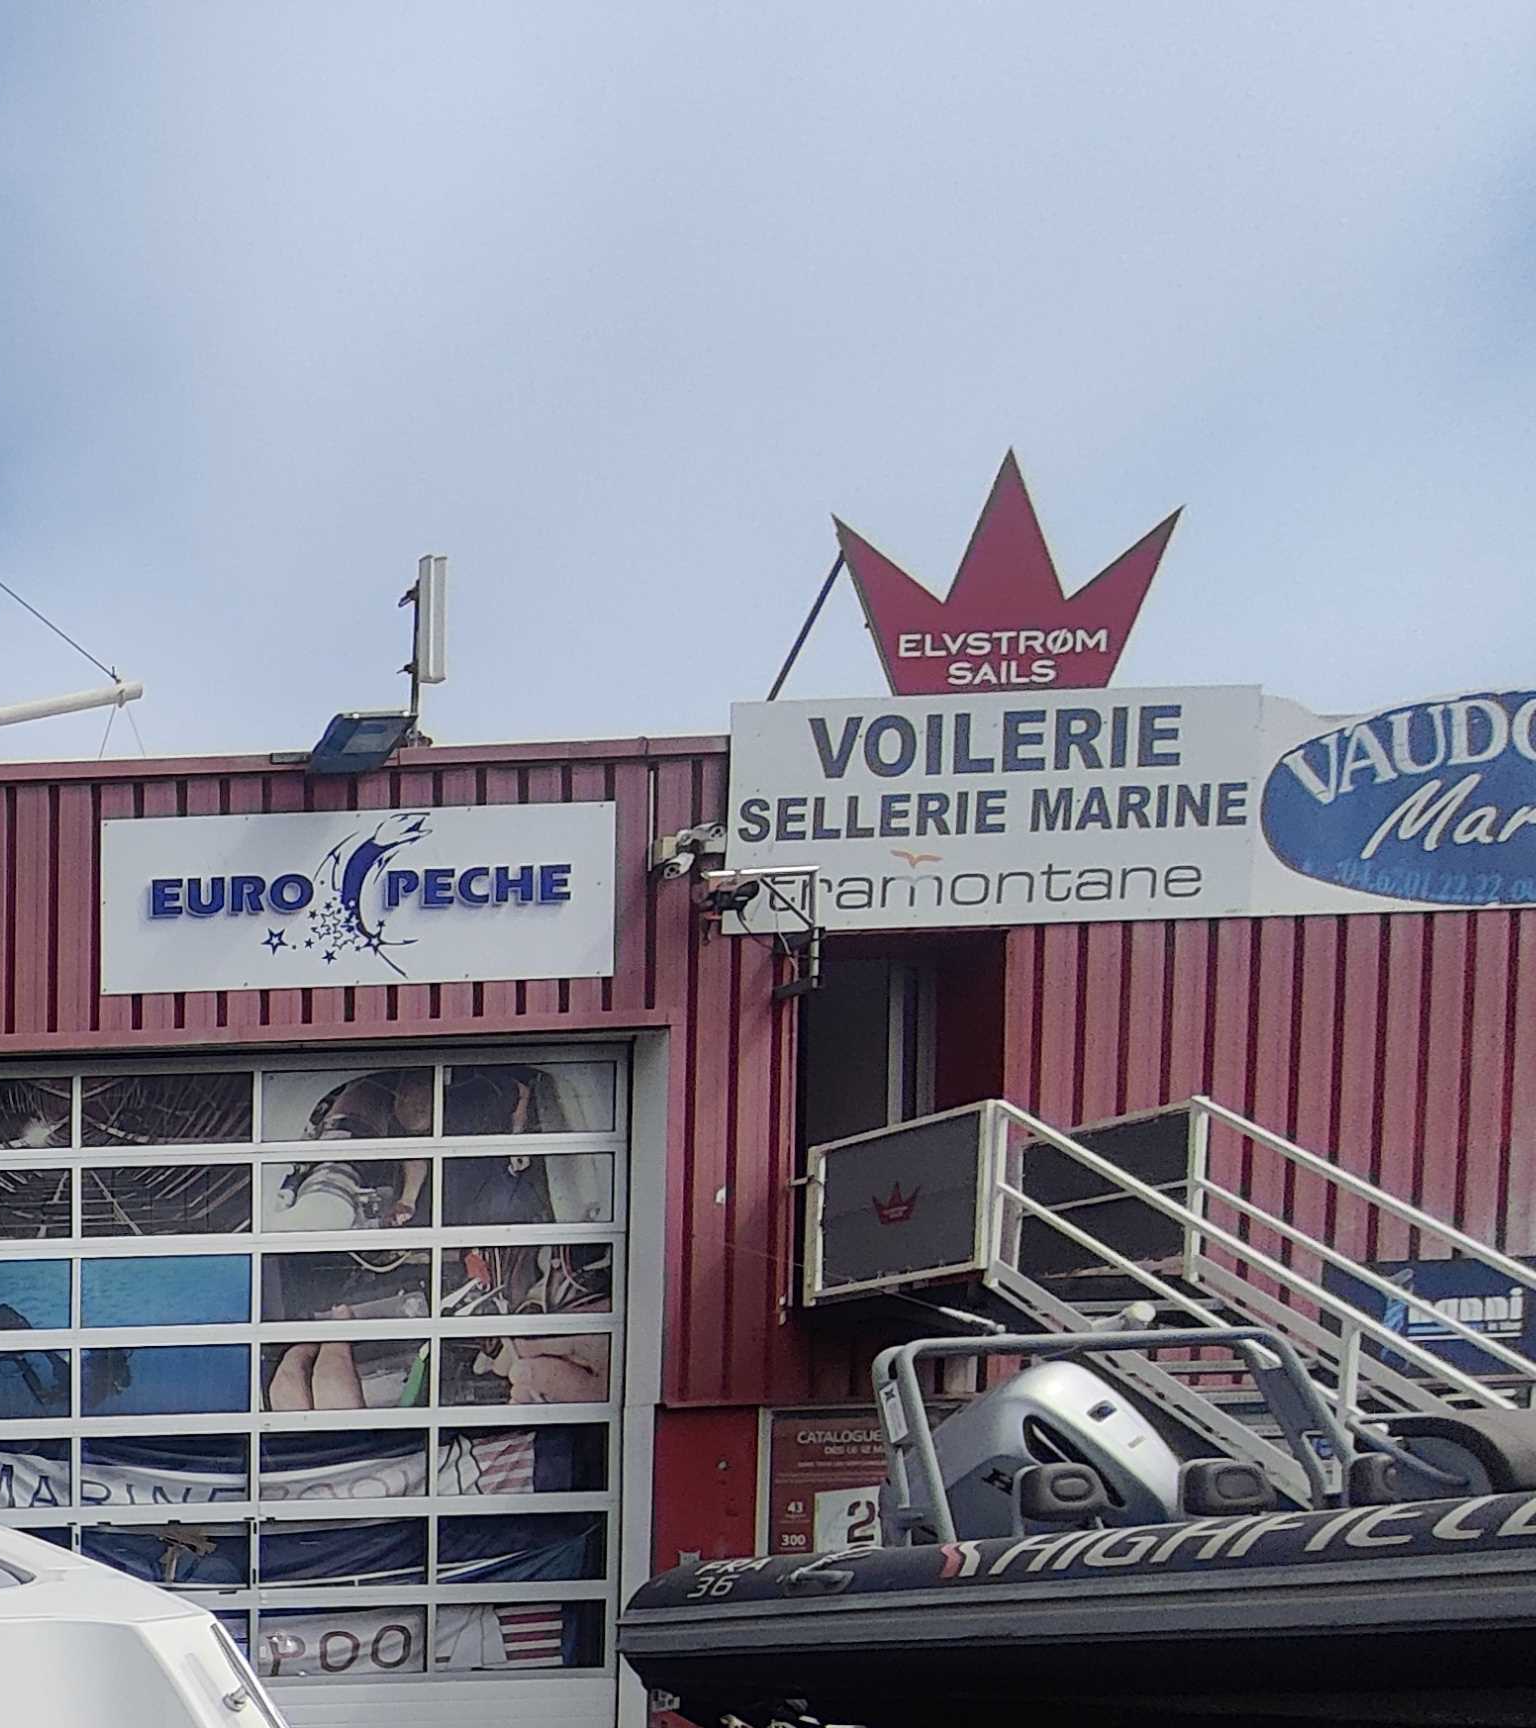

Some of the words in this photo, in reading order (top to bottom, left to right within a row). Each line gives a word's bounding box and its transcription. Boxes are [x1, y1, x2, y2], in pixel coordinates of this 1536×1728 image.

[897, 625, 1110, 659] ELVSTRØM
[947, 656, 1059, 687] SAILS
[808, 703, 1183, 779] VOILERIE
[738, 787, 1007, 844] SELLERIE
[1029, 781, 1249, 834] MARINE
[149, 872, 315, 918] EURO
[385, 863, 573, 908] PECHE
[768, 862, 1203, 911] tramontane
[781, 1534, 806, 1546] 300
[686, 1574, 740, 1599] 36
